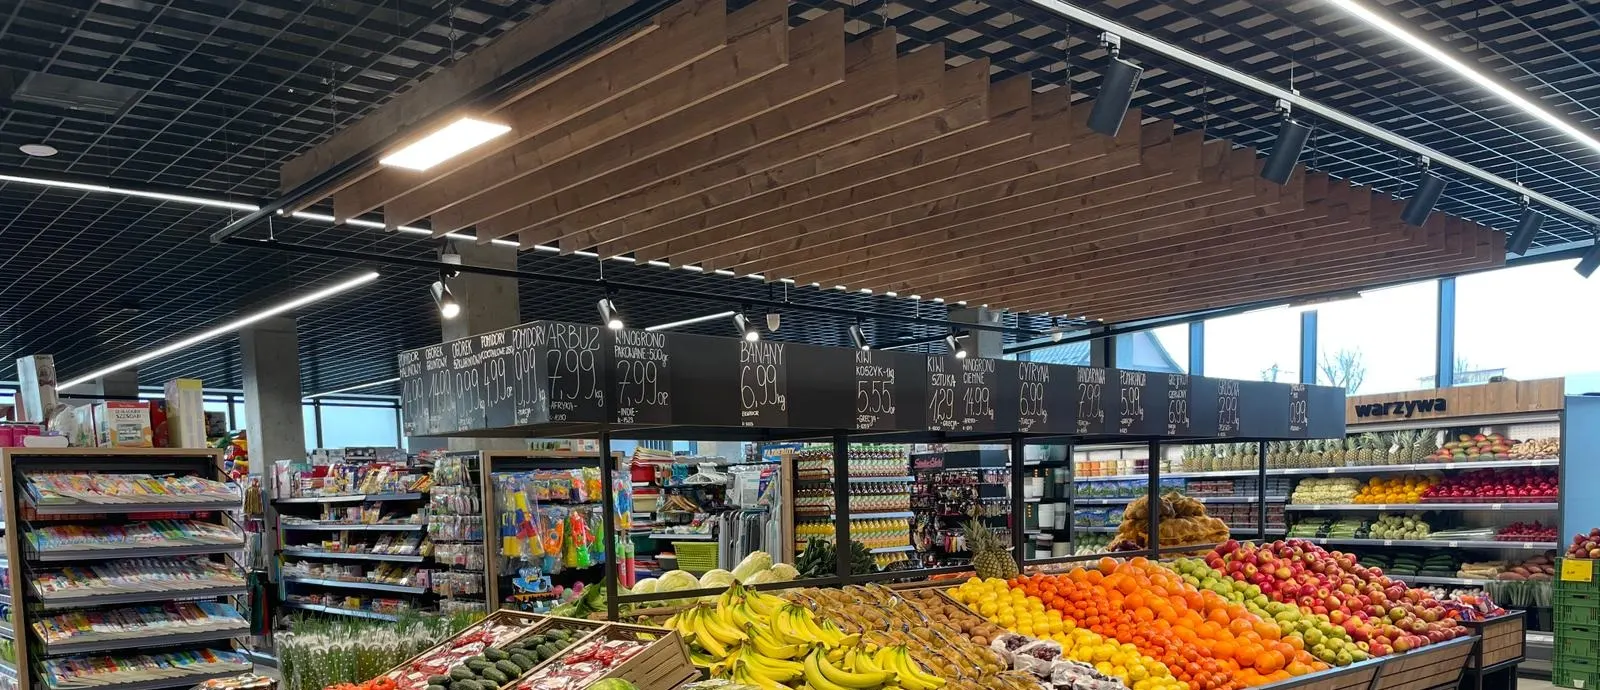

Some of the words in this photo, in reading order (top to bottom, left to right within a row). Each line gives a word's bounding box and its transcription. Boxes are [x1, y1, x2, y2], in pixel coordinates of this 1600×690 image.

[512, 324, 546, 350] POMIDORY
[546, 323, 600, 351] ARBUZ
[740, 341, 784, 365] BANANY
[855, 351, 872, 364] KIWI
[927, 356, 945, 372] KIWI
[514, 347, 538, 407] 9,99
[546, 349, 596, 400] 7,99
[594, 388, 604, 408] kg
[617, 360, 657, 406] 7,99
[931, 373, 956, 387] SZTUKA
[963, 372, 985, 385] CIEMNE
[1019, 361, 1050, 383] CYTRYNA
[740, 364, 777, 409] 6,99
[857, 380, 891, 413] 5,55
[1020, 381, 1044, 416] 6,99
[1120, 386, 1140, 416] 5,99
[1168, 399, 1187, 424] 6,99
[1355, 398, 1447, 418] warzywa
